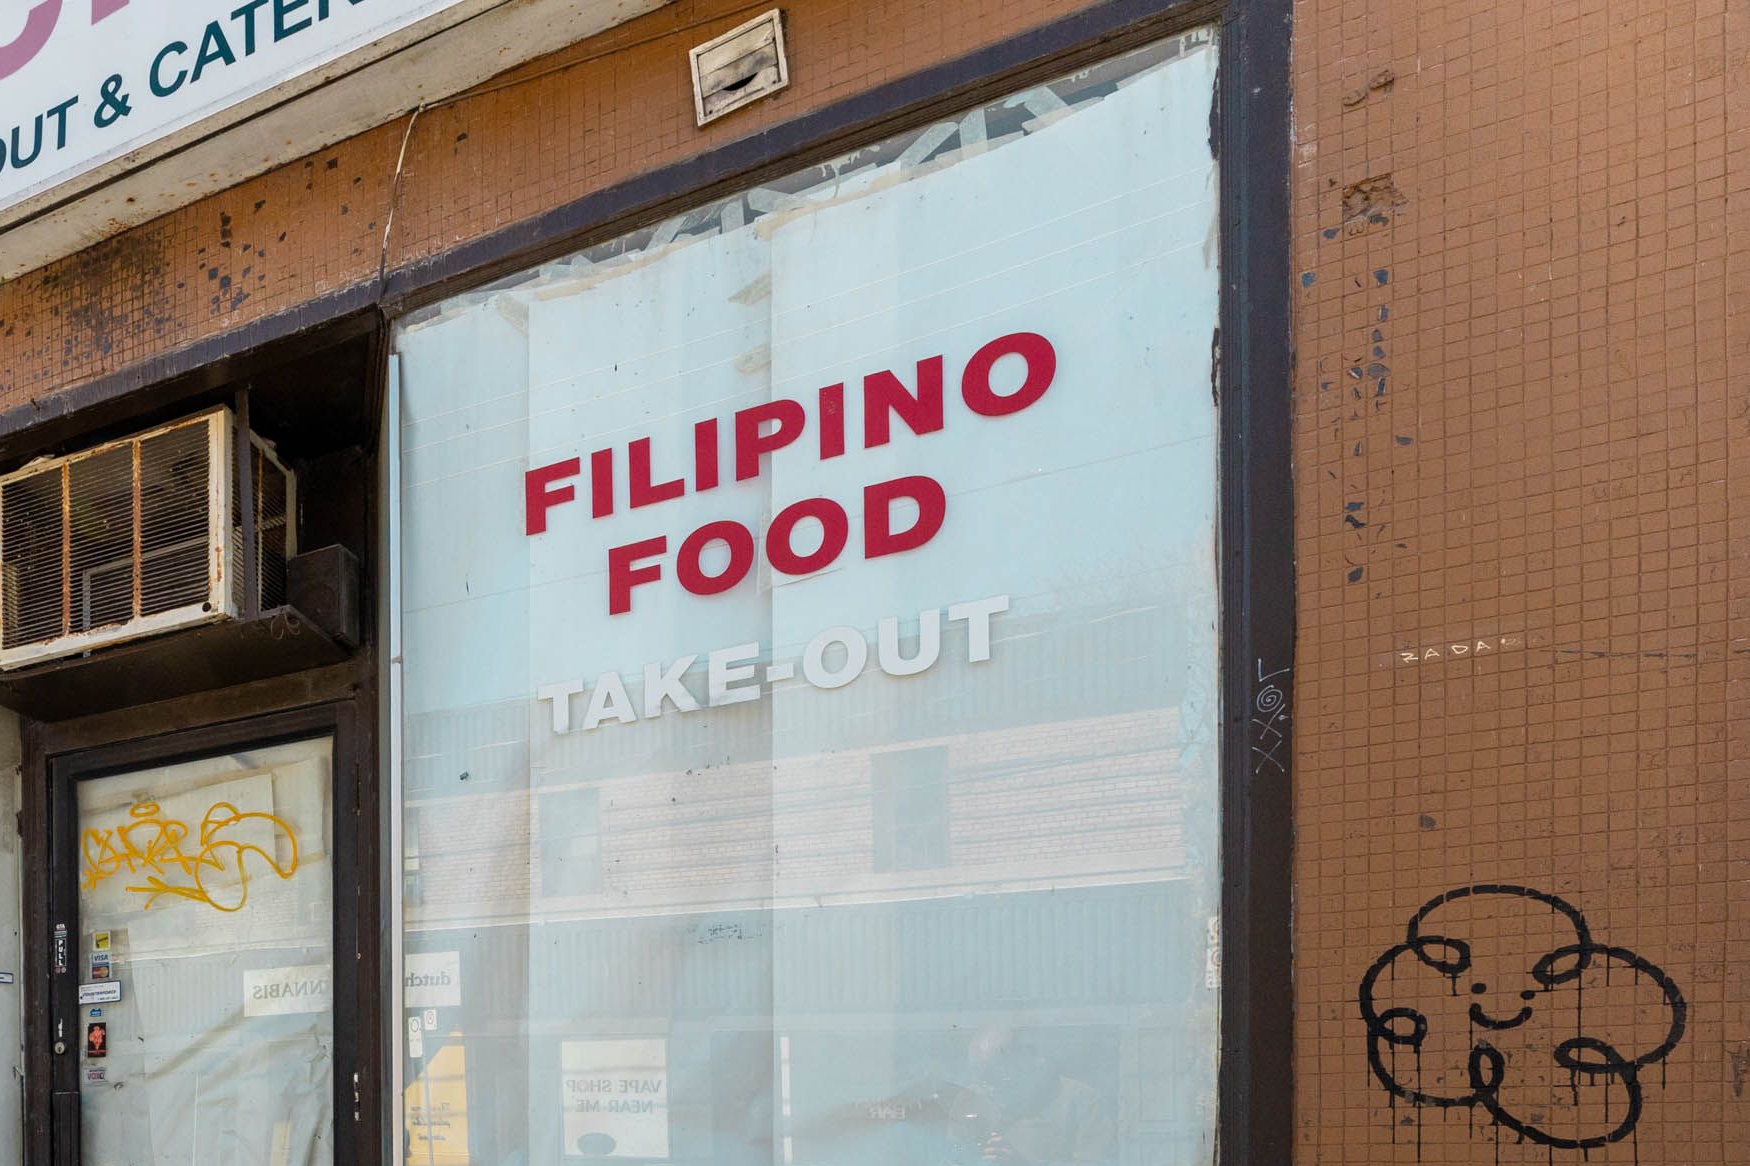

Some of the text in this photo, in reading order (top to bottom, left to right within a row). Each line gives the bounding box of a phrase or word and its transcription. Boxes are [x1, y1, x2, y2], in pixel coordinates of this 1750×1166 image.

[93, 73, 132, 128] &
[525, 332, 1057, 536] FILIPINO
[608, 475, 947, 616] FOOD
[537, 594, 1010, 735] TAKE-OUT
[94, 954, 109, 962] VISA
